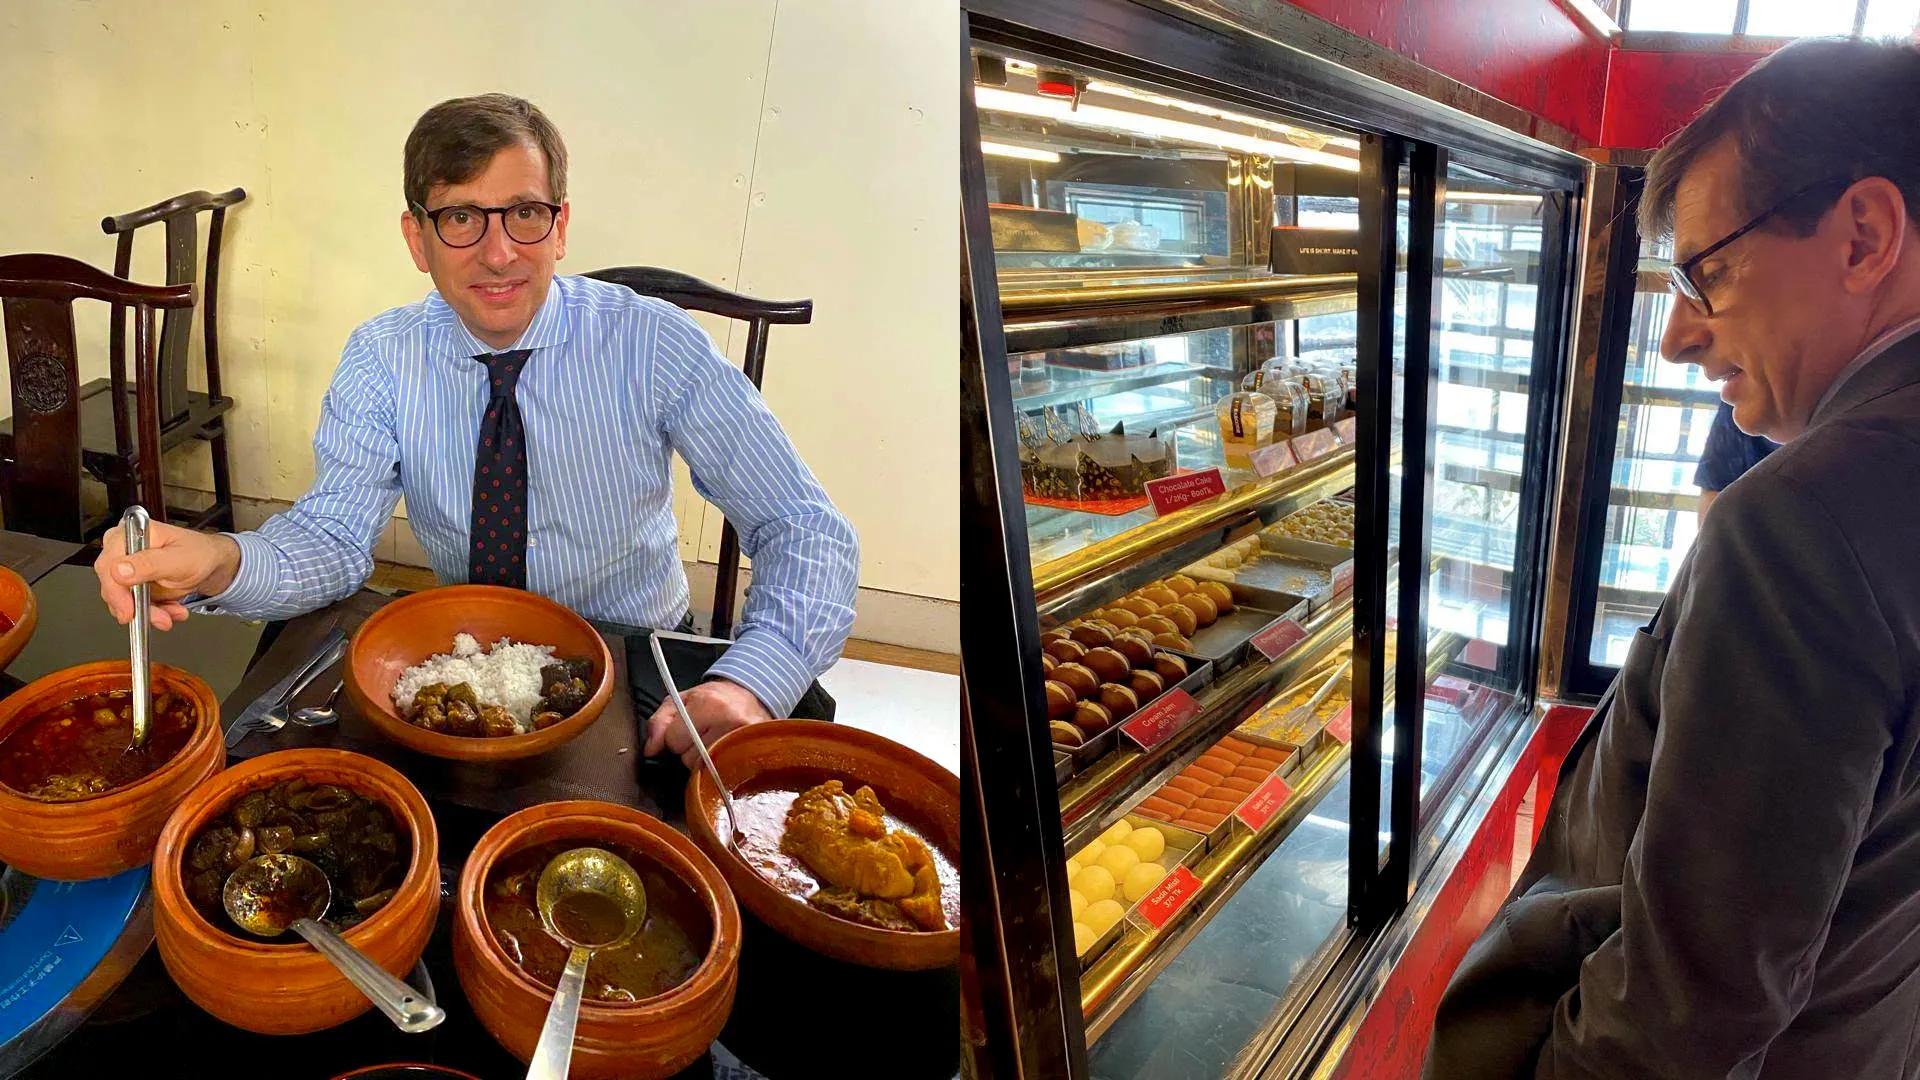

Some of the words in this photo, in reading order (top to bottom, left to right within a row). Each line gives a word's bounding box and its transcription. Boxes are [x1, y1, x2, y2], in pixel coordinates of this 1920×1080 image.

[1195, 475, 1212, 485] Cake
[1142, 710, 1164, 727] Cream
[1162, 702, 1177, 714] Jam
[1151, 889, 1168, 905] Sada
[1163, 895, 1175, 908] 370
